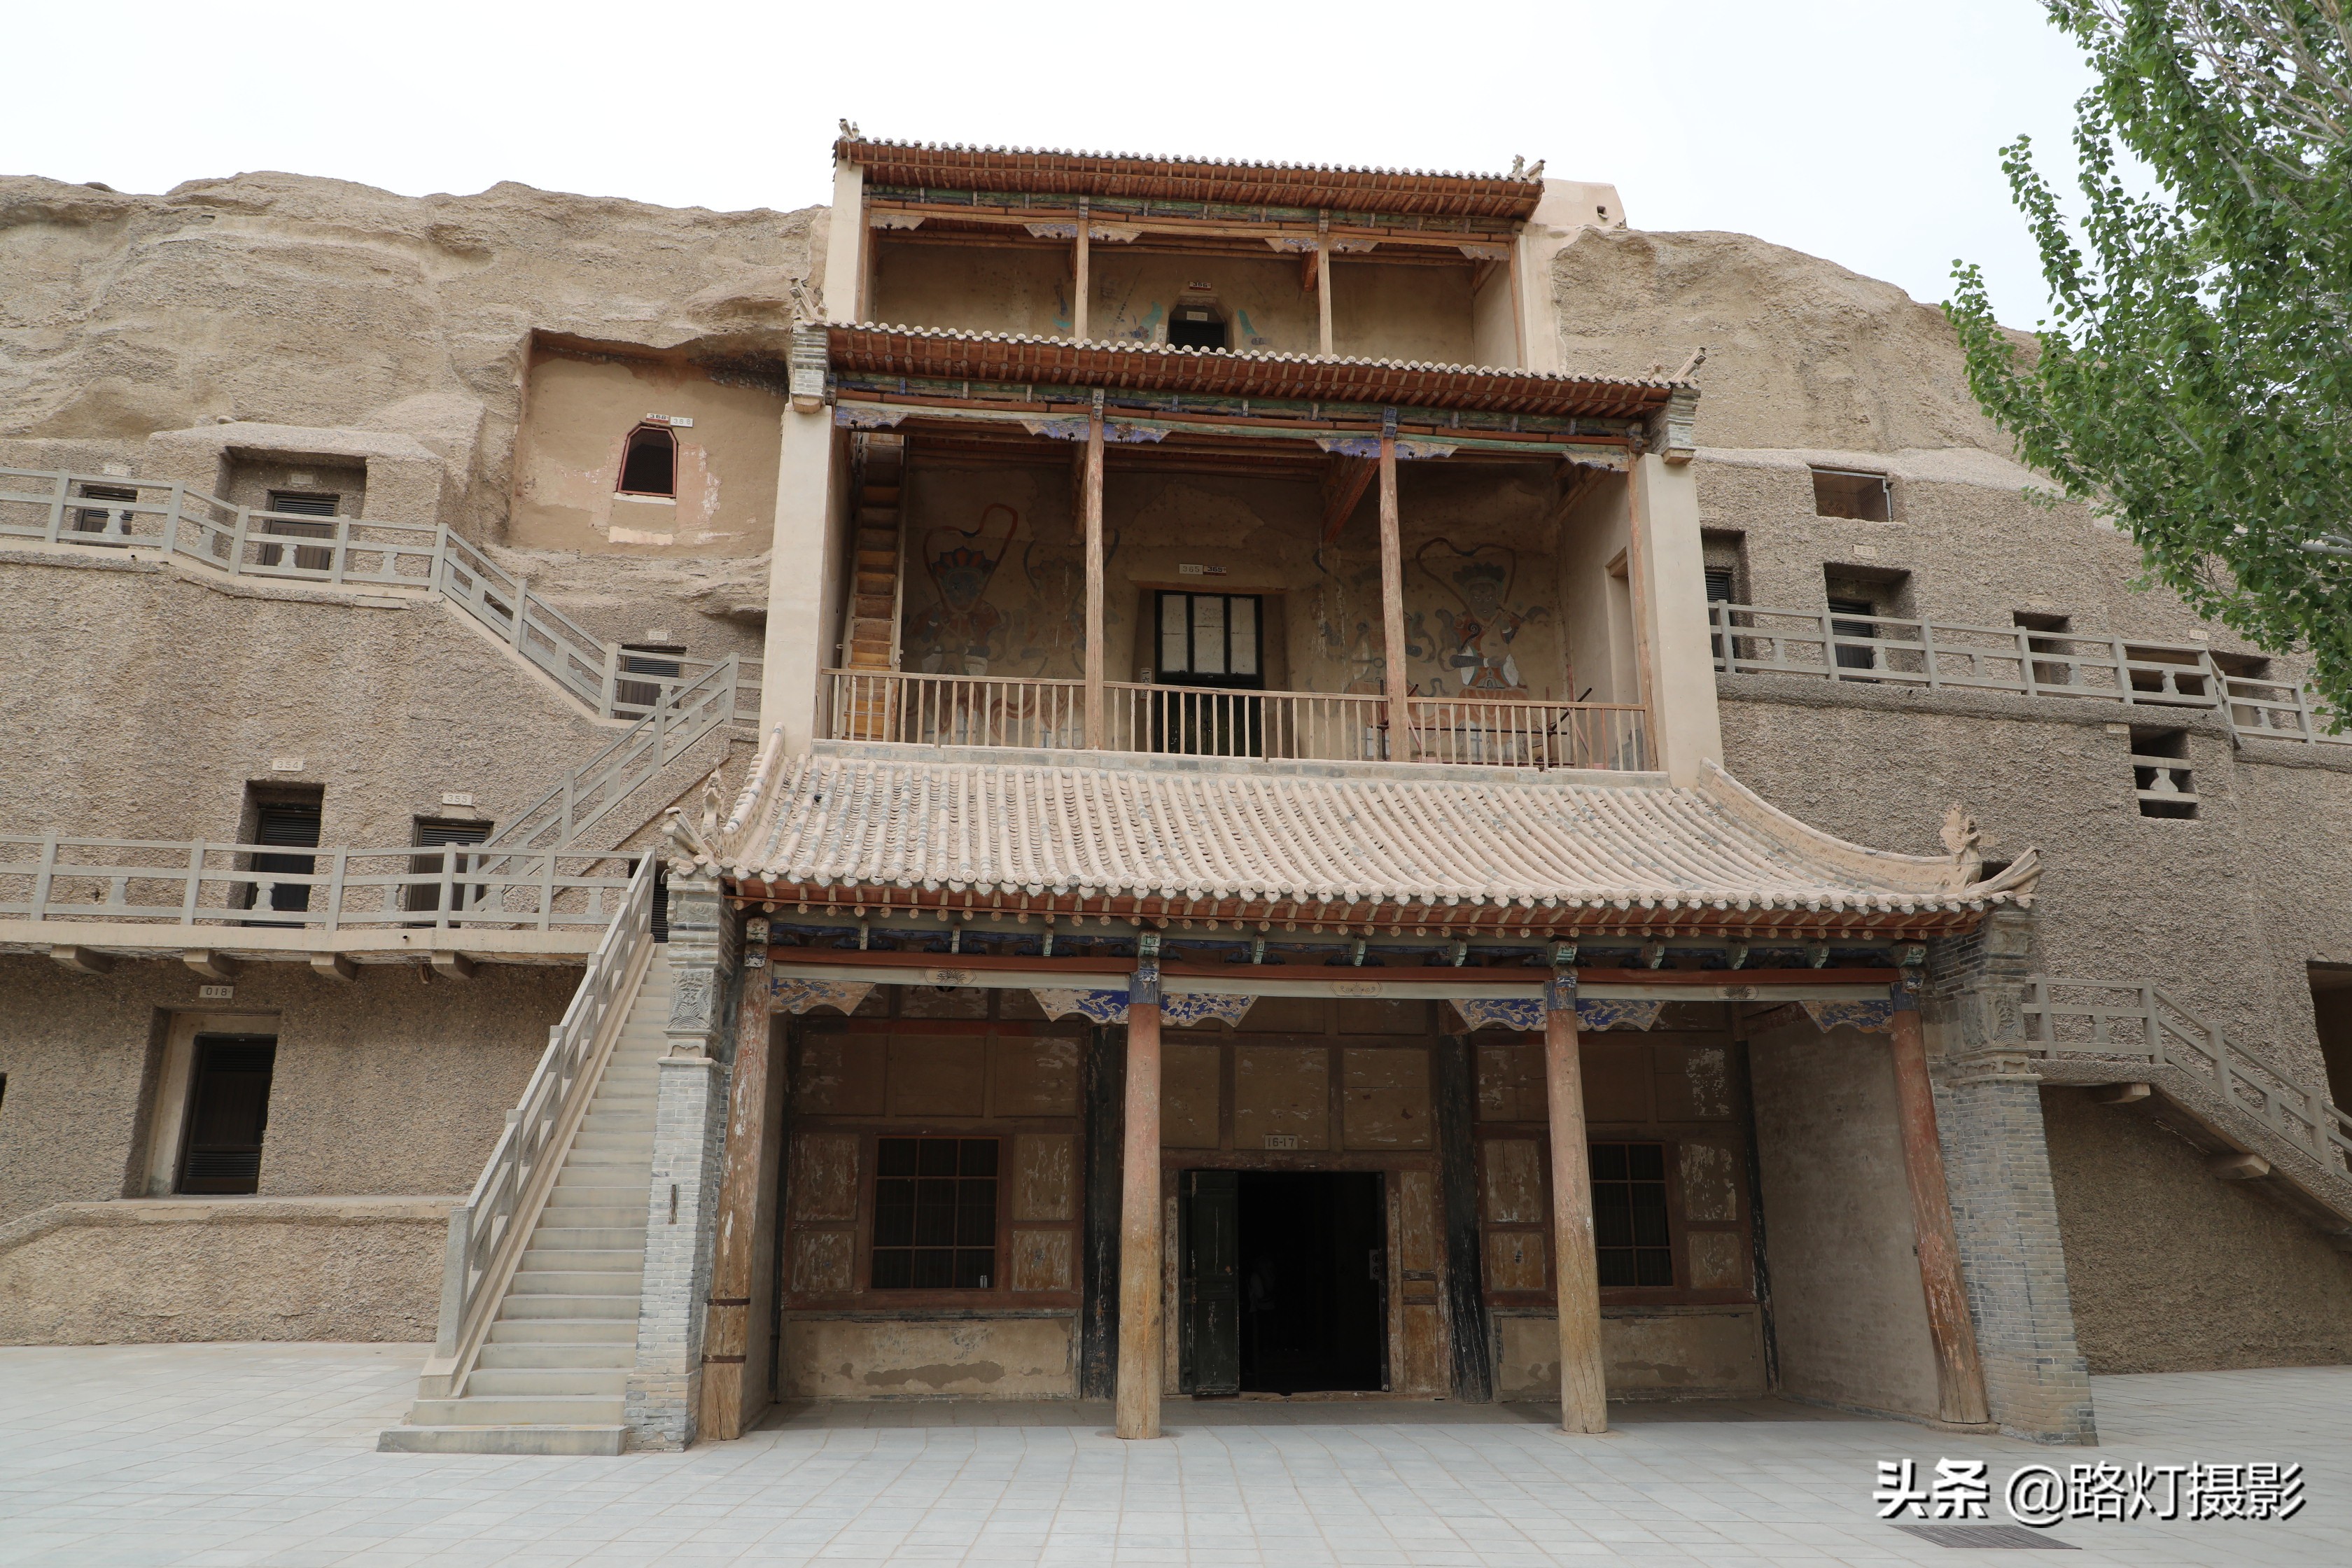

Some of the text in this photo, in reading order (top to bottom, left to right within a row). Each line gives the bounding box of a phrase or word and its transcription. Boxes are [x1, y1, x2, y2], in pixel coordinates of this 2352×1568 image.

[276, 760, 299, 769] 354
[447, 794, 468, 804] 355
[206, 987, 227, 996] 018
[1267, 1137, 1295, 1148] 16-17
